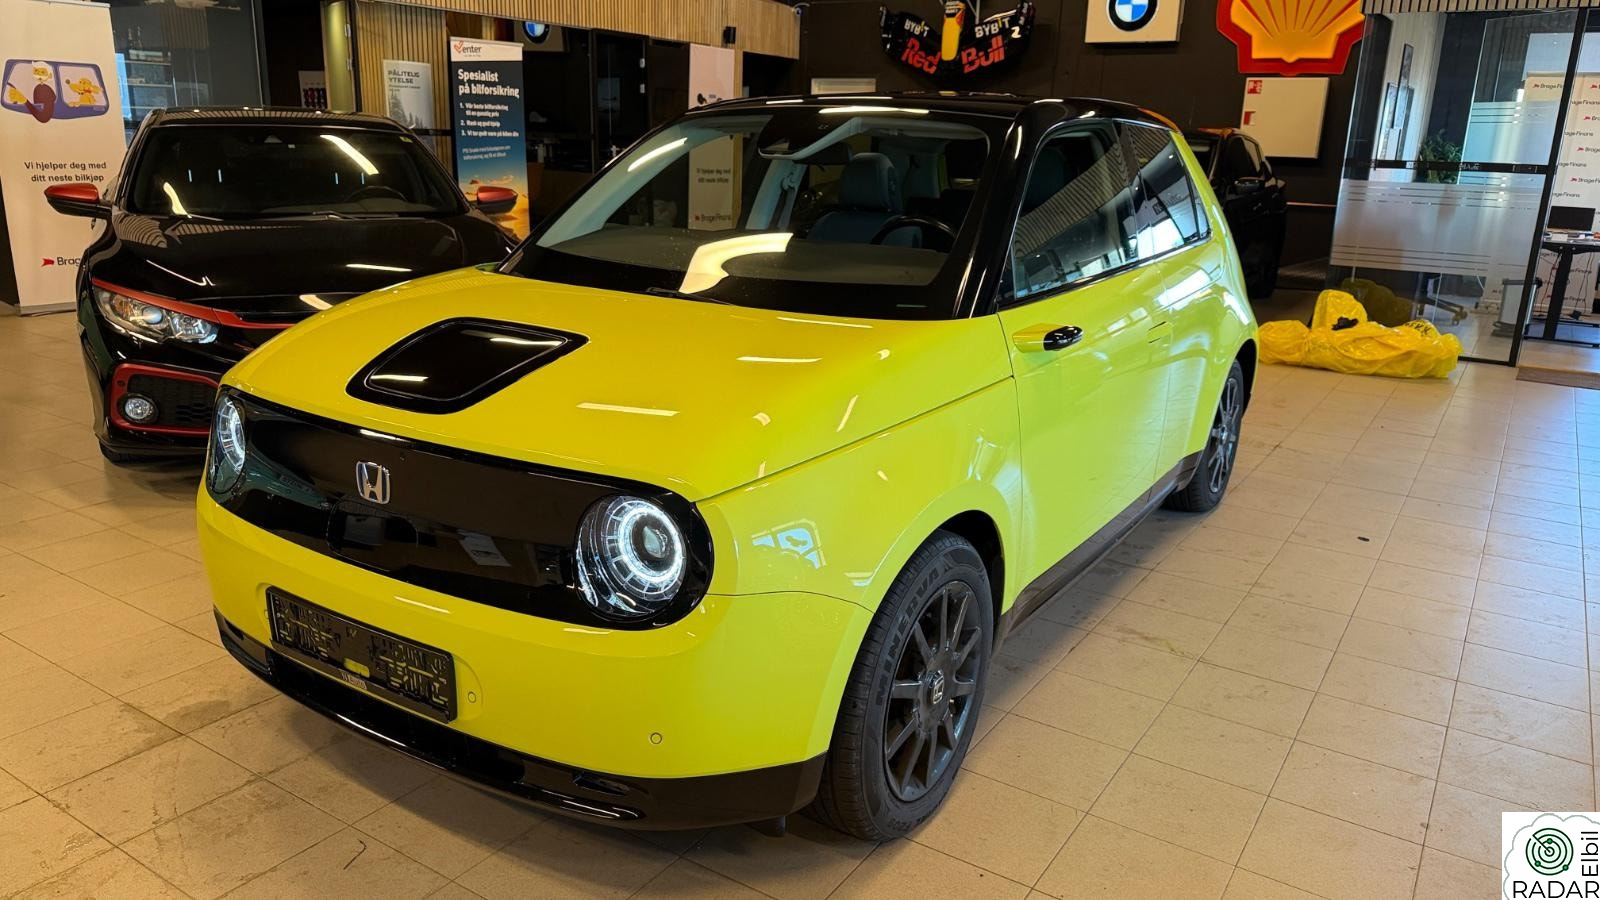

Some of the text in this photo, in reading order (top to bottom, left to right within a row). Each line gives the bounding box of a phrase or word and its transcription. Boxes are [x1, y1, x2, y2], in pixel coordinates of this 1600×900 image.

[975, 17, 1010, 38] BYBIT
[902, 34, 1005, 74] Red Bull
[458, 68, 498, 82] Spesialist
[458, 83, 520, 99] på bilforsikring
[36, 162, 67, 171] hjelper
[70, 162, 86, 170] deg
[57, 257, 80, 266] Brag
[876, 566, 940, 706] MINERVA
